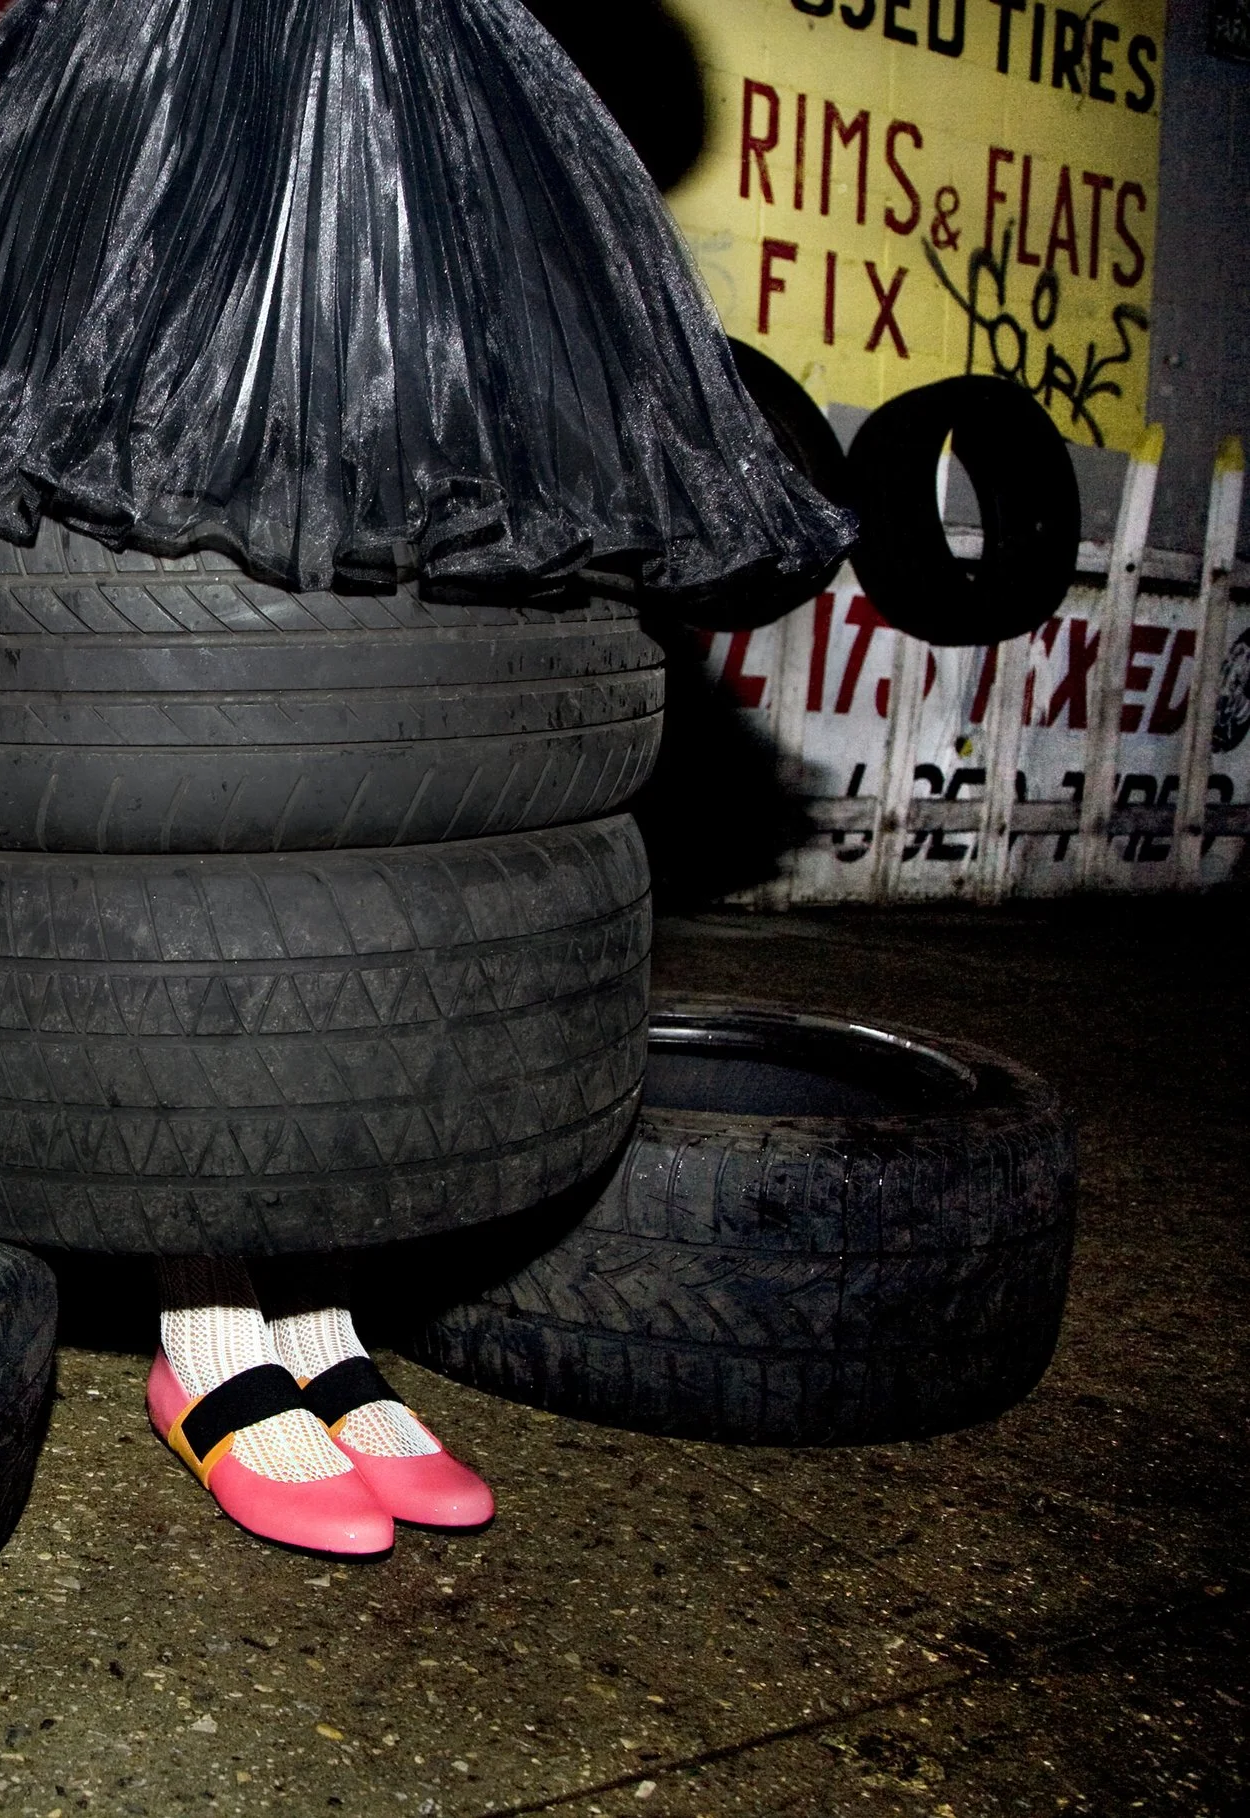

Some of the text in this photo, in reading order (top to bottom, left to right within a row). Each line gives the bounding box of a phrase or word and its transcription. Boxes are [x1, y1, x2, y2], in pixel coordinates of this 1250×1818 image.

[791, 0, 1158, 113] ED TIRES
[739, 77, 1147, 288] RIMS & FLATS
[757, 237, 910, 360] FIX
